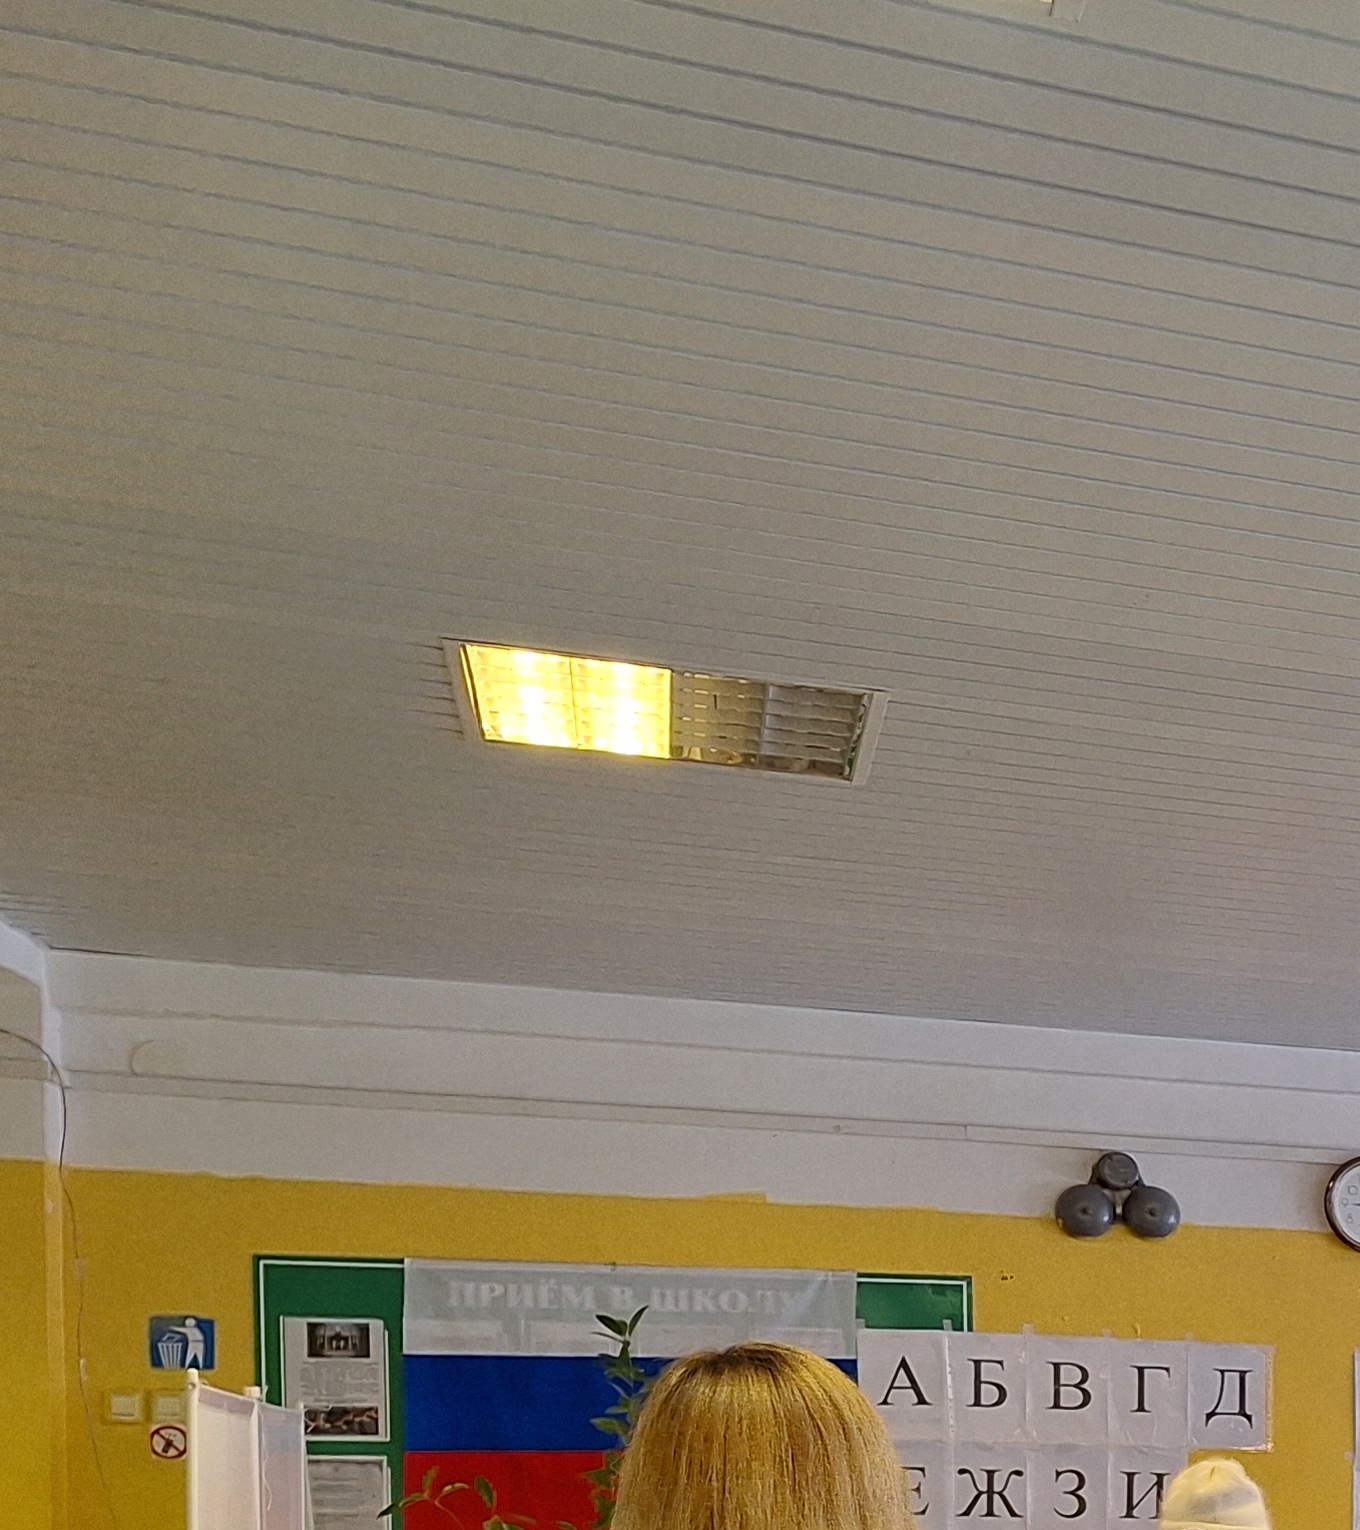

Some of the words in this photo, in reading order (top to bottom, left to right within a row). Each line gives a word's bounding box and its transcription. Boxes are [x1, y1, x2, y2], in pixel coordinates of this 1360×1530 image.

[877, 1355, 932, 1407] А
[966, 1358, 1008, 1408] Б
[1045, 1361, 1092, 1411] В
[1129, 1365, 1171, 1413] Г
[1205, 1368, 1253, 1429] Д
[956, 1468, 1024, 1518] Ж
[1053, 1469, 1086, 1519] З
[1119, 1471, 1172, 1520] И
